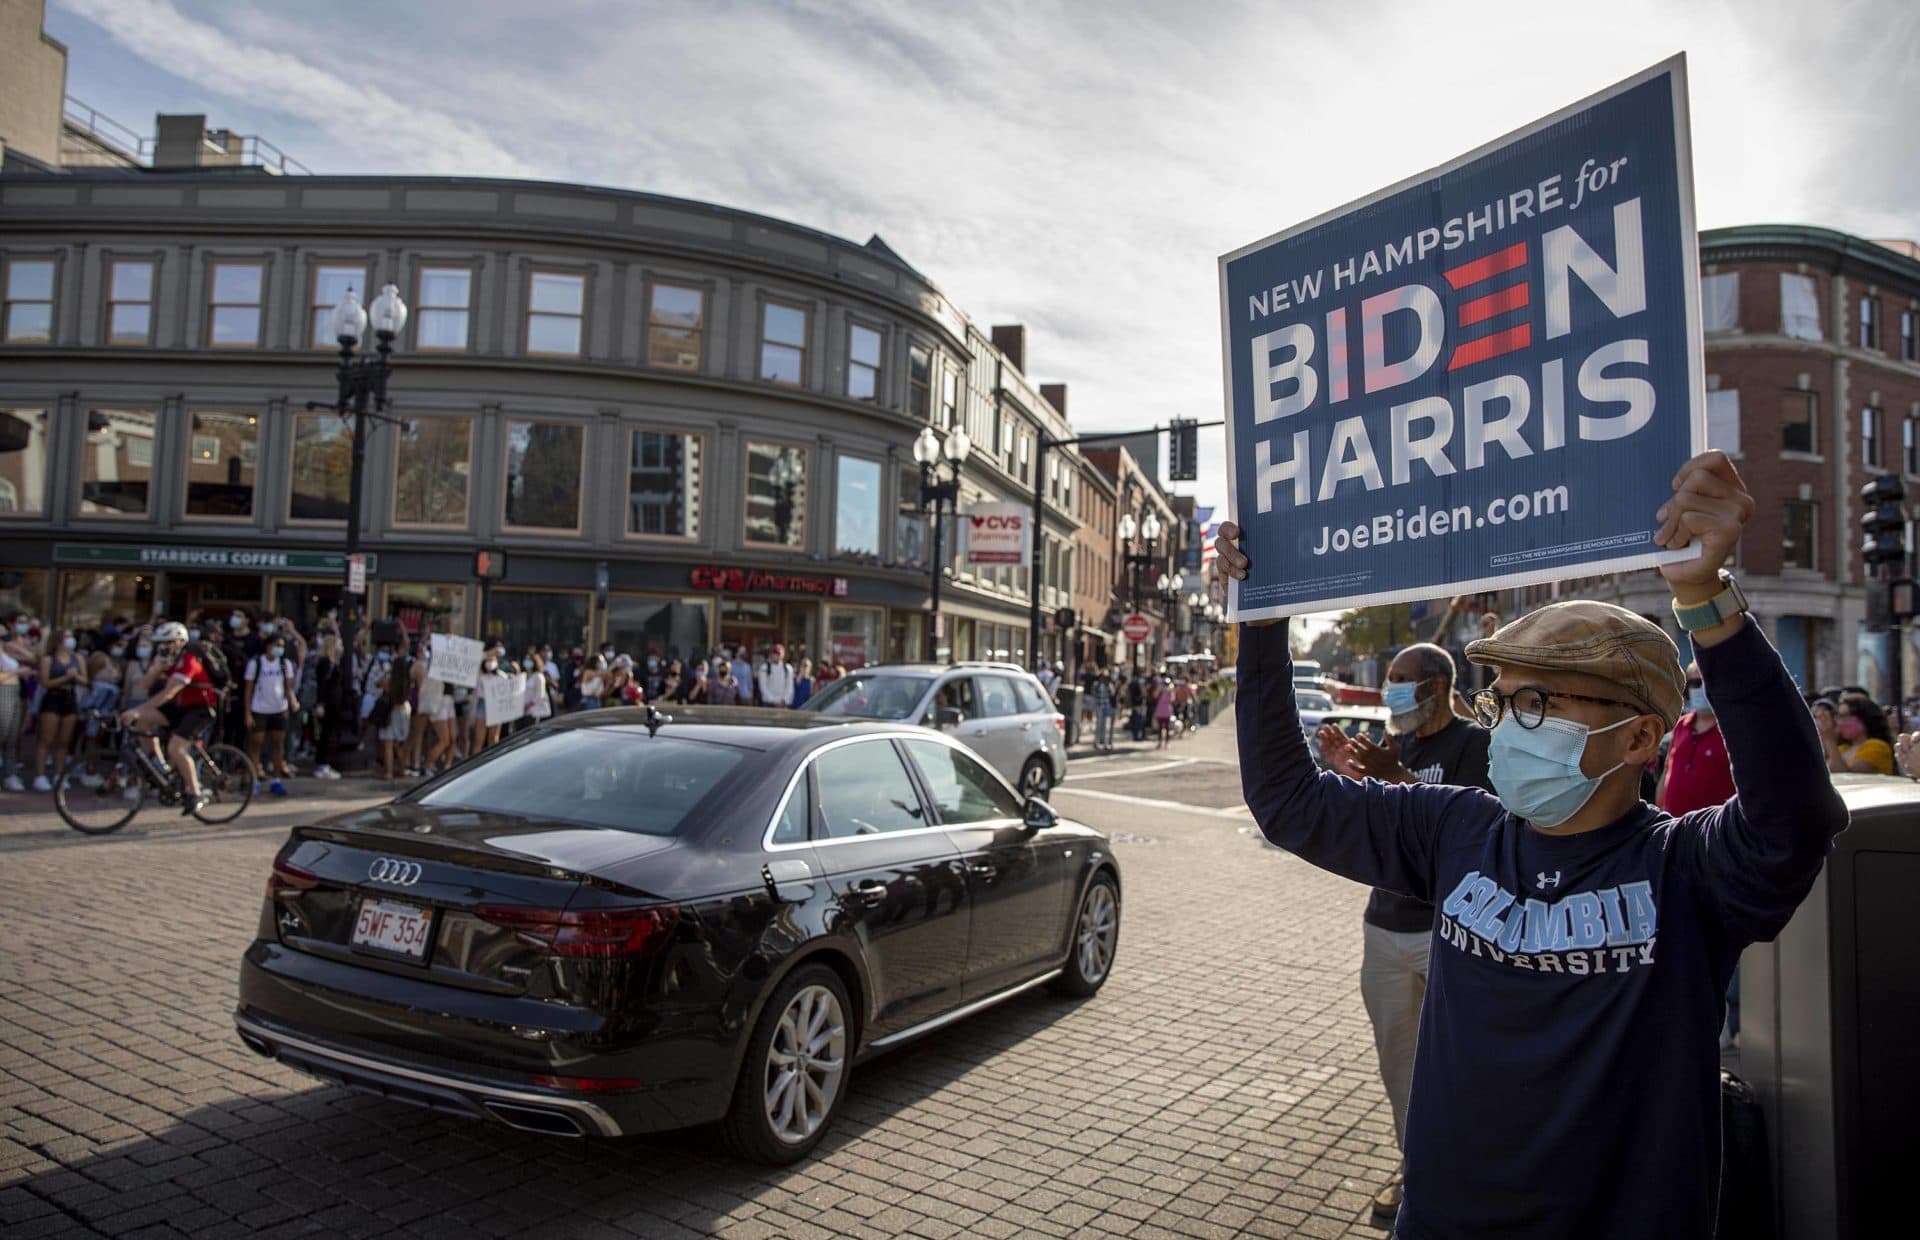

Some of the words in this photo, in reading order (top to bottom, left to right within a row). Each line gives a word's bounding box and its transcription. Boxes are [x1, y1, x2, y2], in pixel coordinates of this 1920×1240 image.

[1249, 270, 1323, 321] NEW
[1334, 174, 1564, 290] HAMPSHIRE
[1570, 156, 1628, 211] for
[1251, 197, 1647, 425] BIDEN
[1255, 339, 1657, 514] HARRIS
[987, 515, 1022, 530] CVS
[1313, 485, 1569, 556] JoeBiden.com
[1493, 556, 1508, 564] PAID
[1547, 545, 1582, 555] HAMPSHIRE
[1582, 538, 1623, 550] DEMOCRATIC
[1624, 534, 1646, 543] PARTY
[140, 549, 228, 563] STARBUCKS
[231, 552, 288, 566] COFFEE
[358, 908, 393, 940] 5WF
[393, 915, 428, 946] 354
[1440, 914, 1657, 975] UNIVERSITY
[1442, 870, 1657, 953] COLUMBIA
